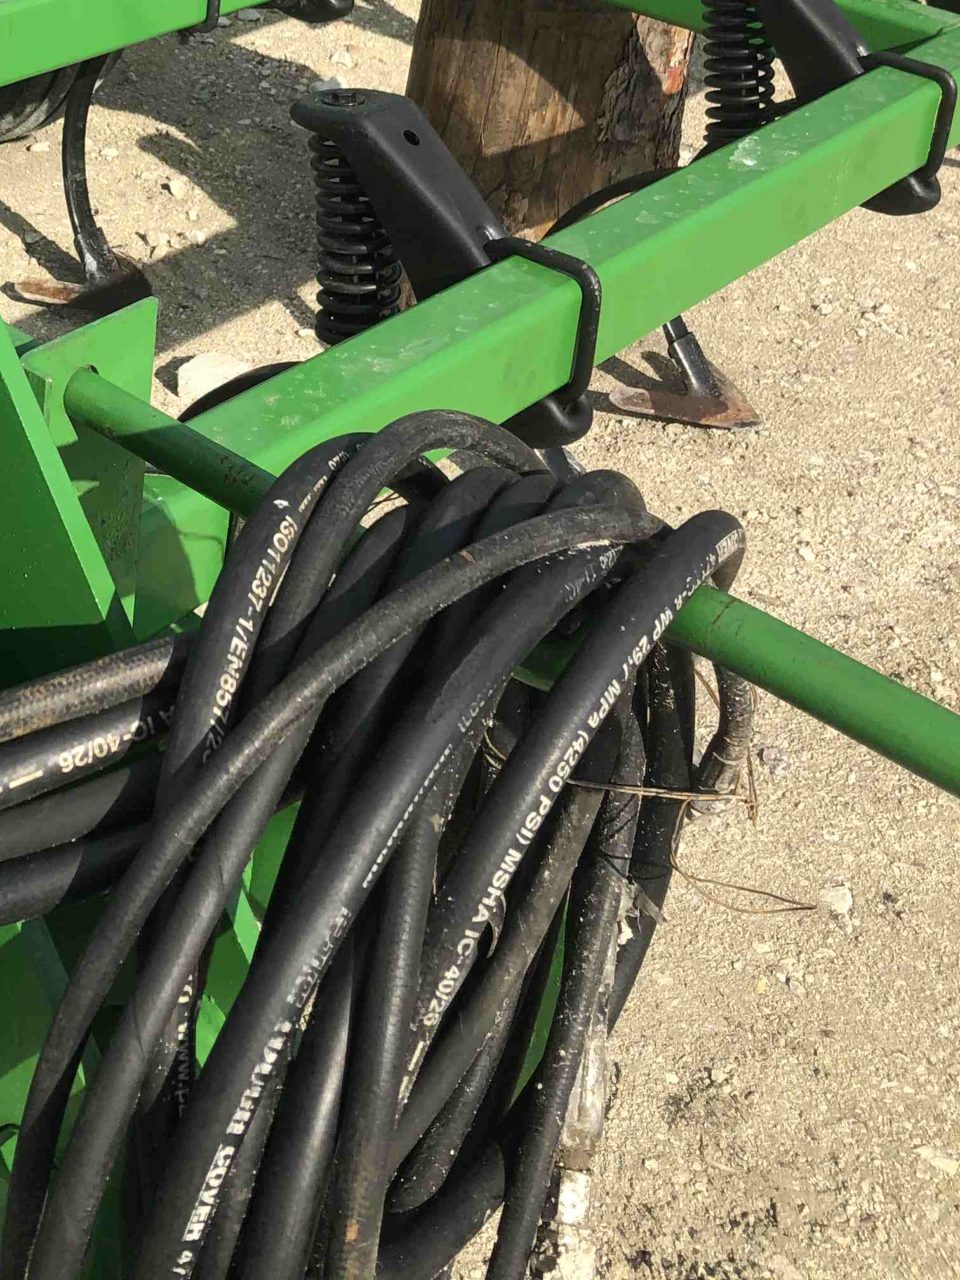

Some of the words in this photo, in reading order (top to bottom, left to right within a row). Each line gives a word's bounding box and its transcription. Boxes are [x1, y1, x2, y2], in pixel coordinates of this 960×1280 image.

[652, 607, 674, 641] WP
[587, 679, 622, 728] MPa
[58, 718, 154, 774] IC-40/26
[548, 730, 589, 793] (4250
[516, 795, 552, 845] PSI)
[471, 848, 522, 923] MSHA
[182, 1144, 235, 1242] COVER
